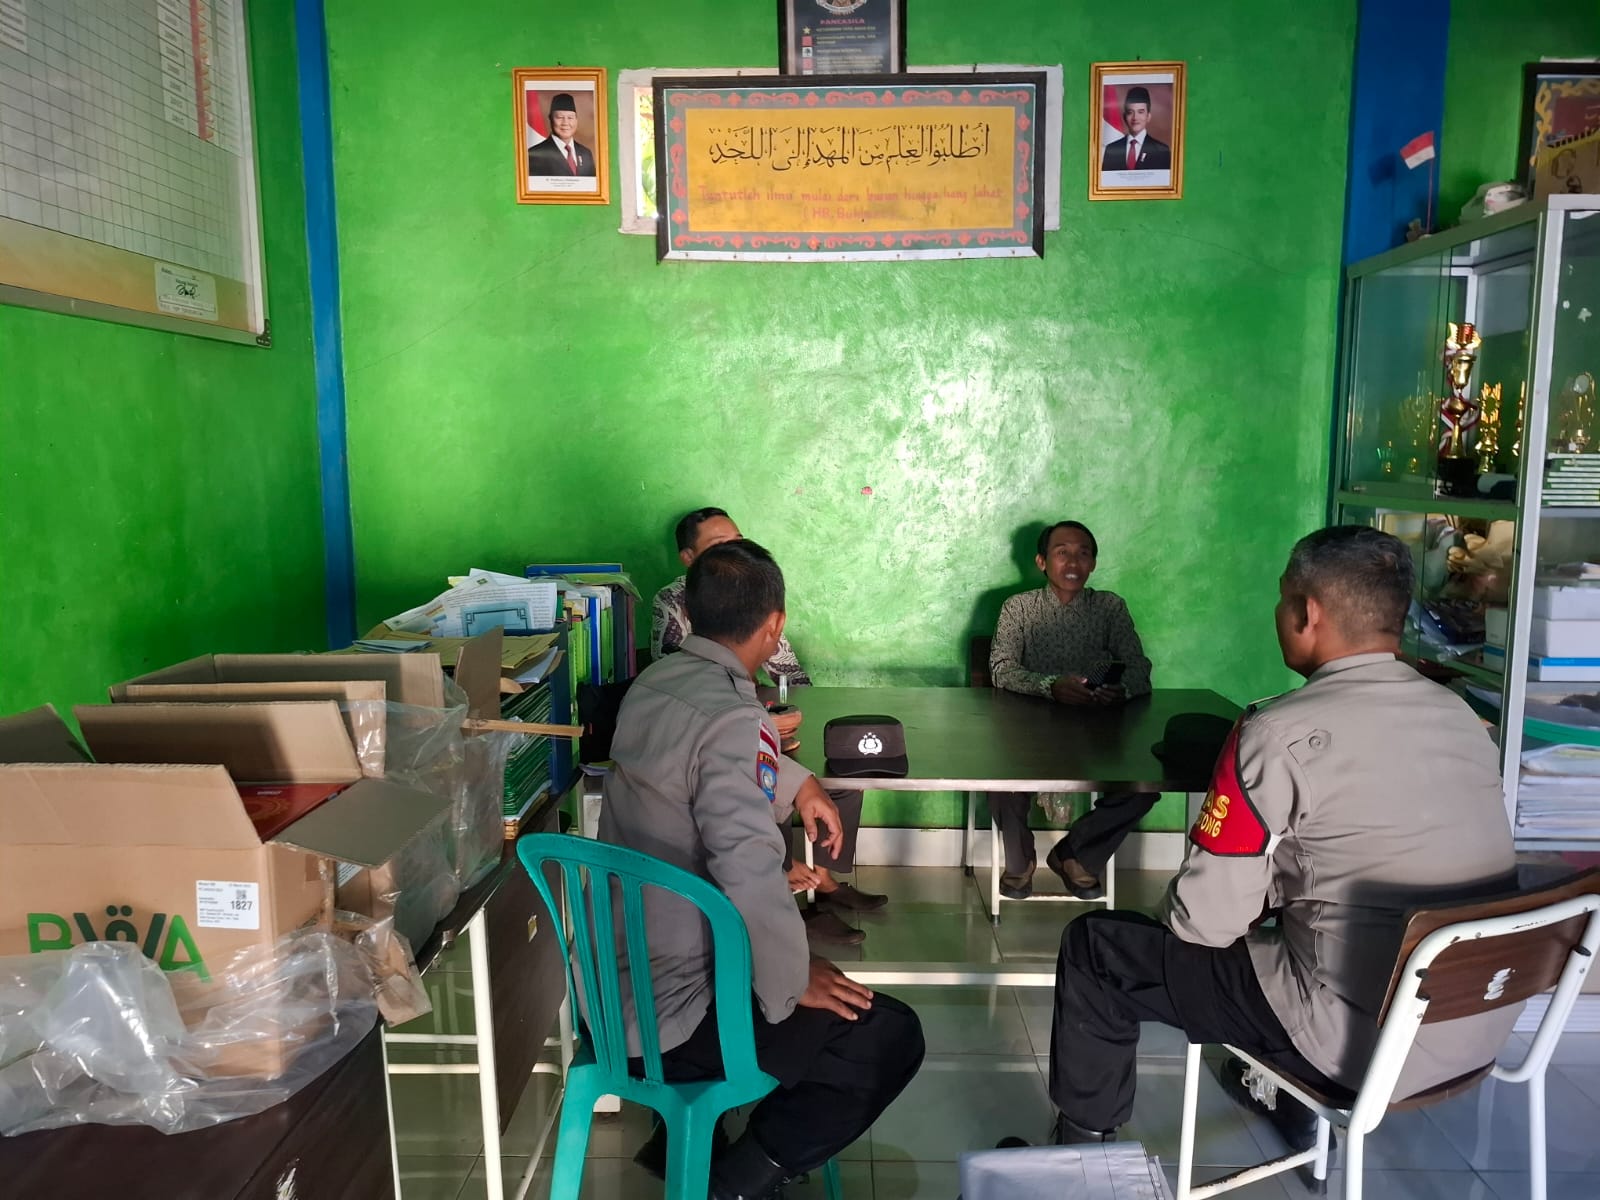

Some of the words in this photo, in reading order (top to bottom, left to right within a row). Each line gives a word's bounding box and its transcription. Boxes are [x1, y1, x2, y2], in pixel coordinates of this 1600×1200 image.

[767, 184, 793, 201] ilmu
[801, 187, 832, 202] mulai
[231, 900, 253, 910] 1827
